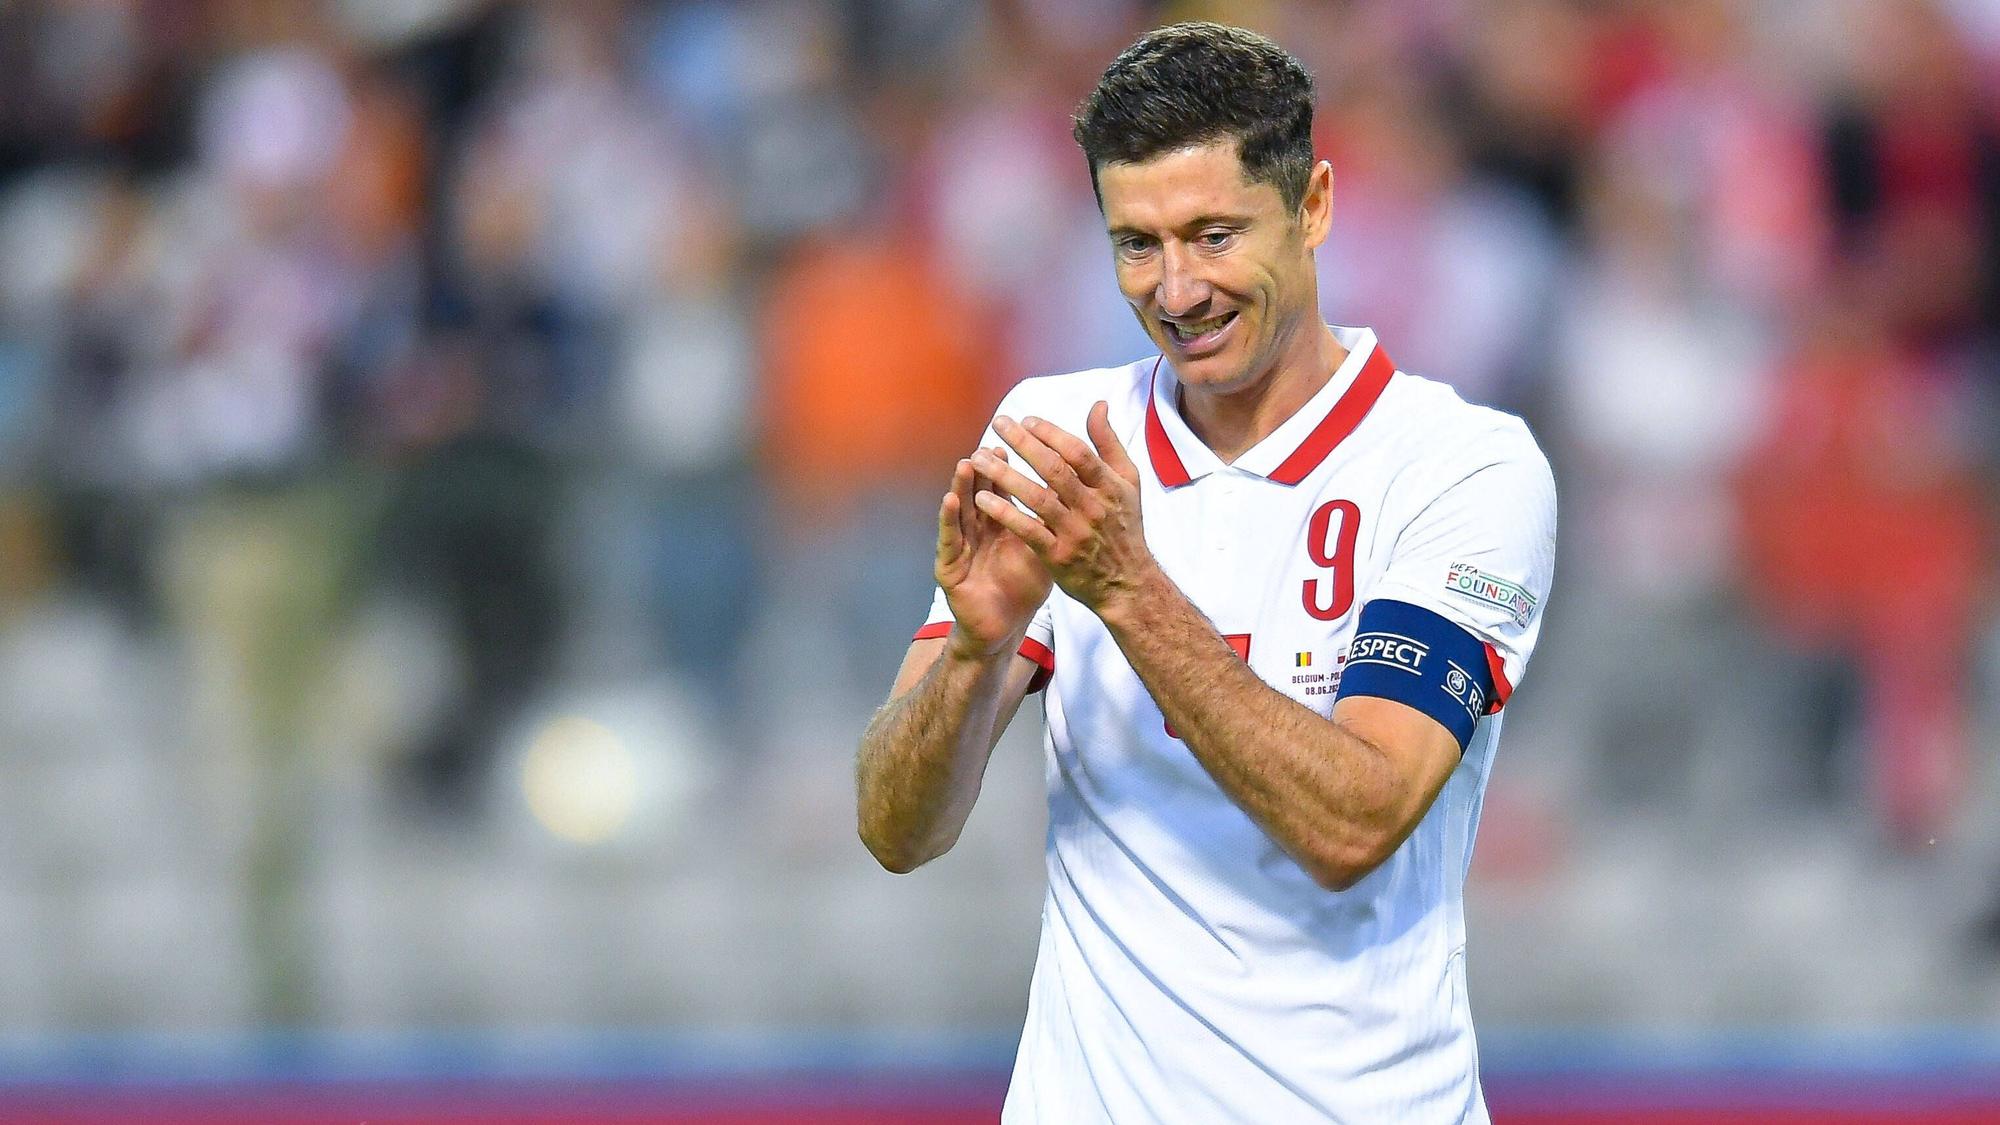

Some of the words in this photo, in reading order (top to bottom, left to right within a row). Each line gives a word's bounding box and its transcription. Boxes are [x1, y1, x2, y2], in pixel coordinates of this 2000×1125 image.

[1302, 499, 1361, 621] 9
[1450, 562, 1478, 574] UEFA
[1347, 639, 1427, 667] ESPECT
[1292, 674, 1324, 684] BELGIUM
